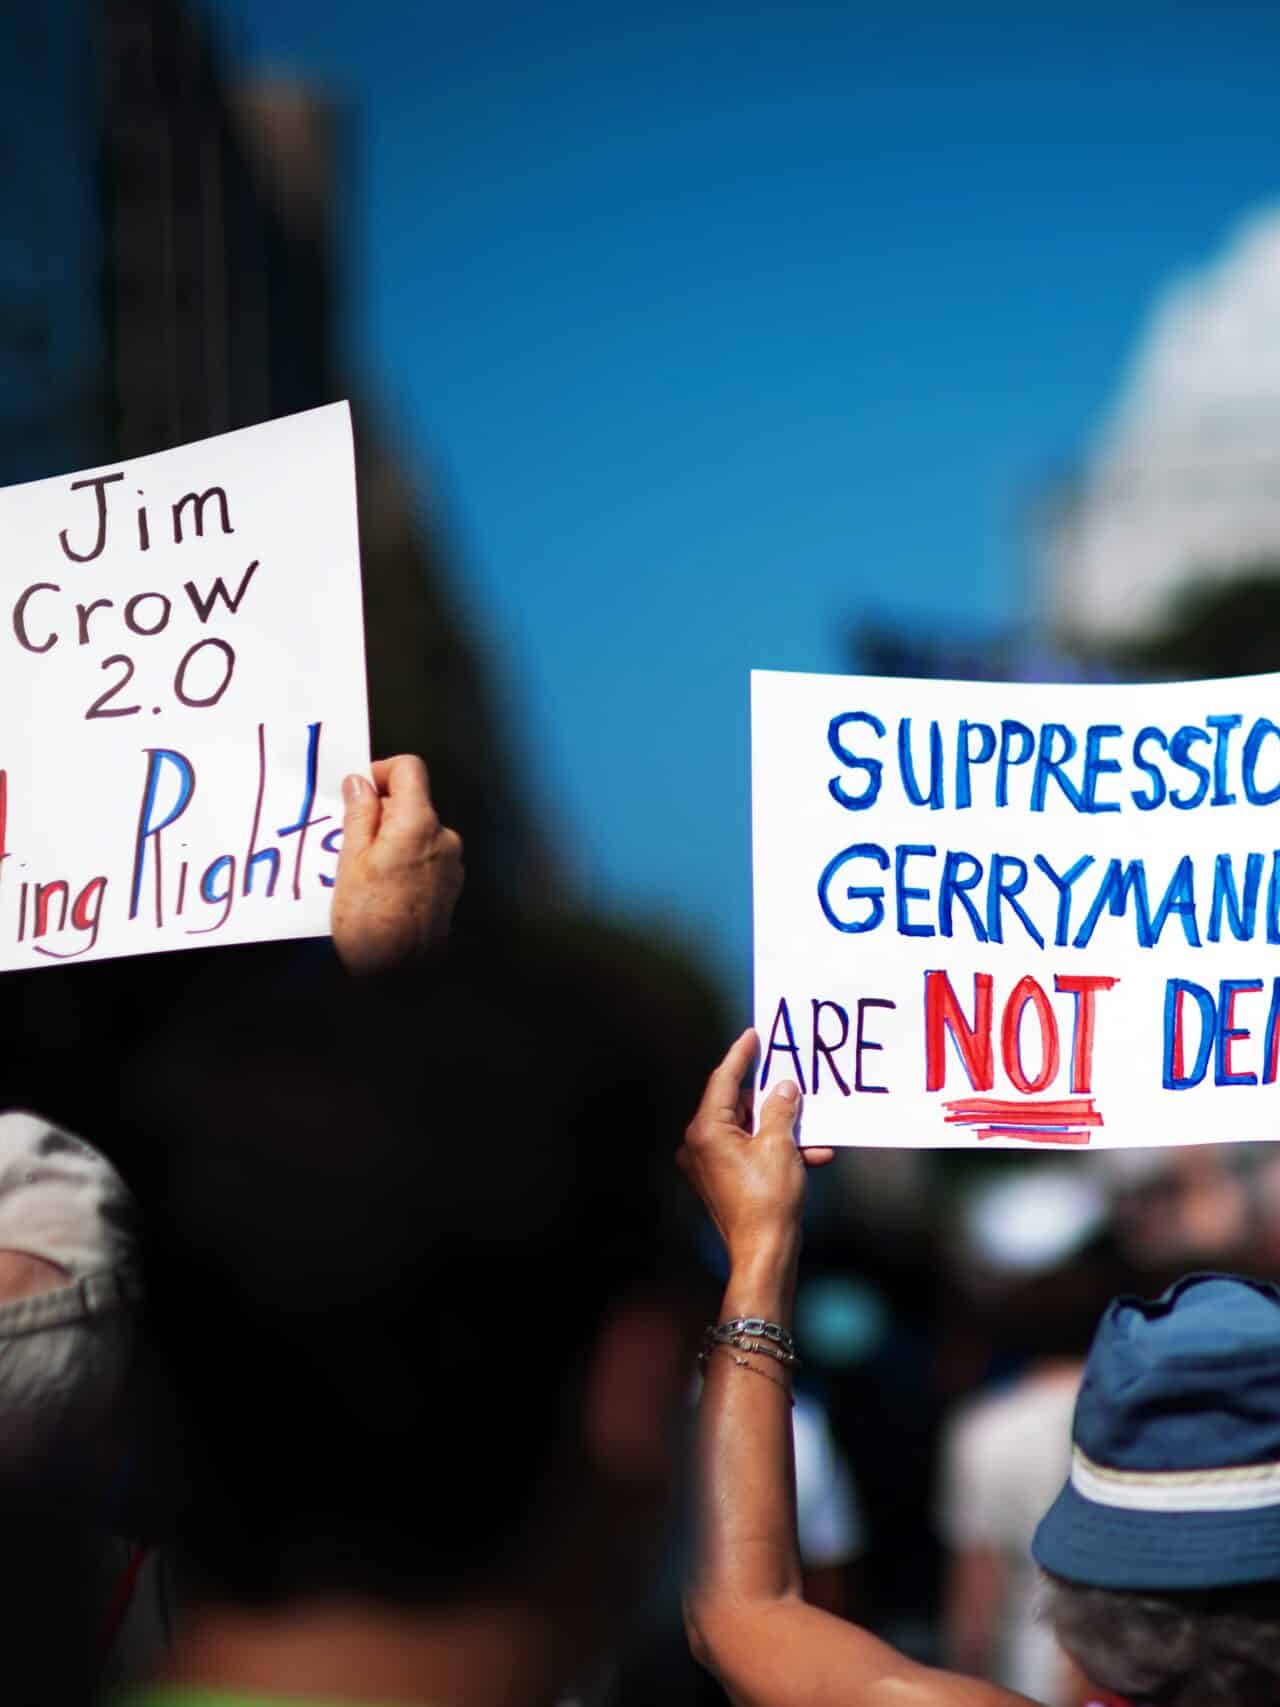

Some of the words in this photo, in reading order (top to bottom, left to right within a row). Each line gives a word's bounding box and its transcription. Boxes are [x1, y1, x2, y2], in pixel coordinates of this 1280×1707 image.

[59, 472, 235, 563] Jim
[13, 560, 260, 653] Crow
[85, 637, 236, 720] 2.0
[759, 997, 896, 1096] ARE
[924, 970, 1121, 1095] NOT
